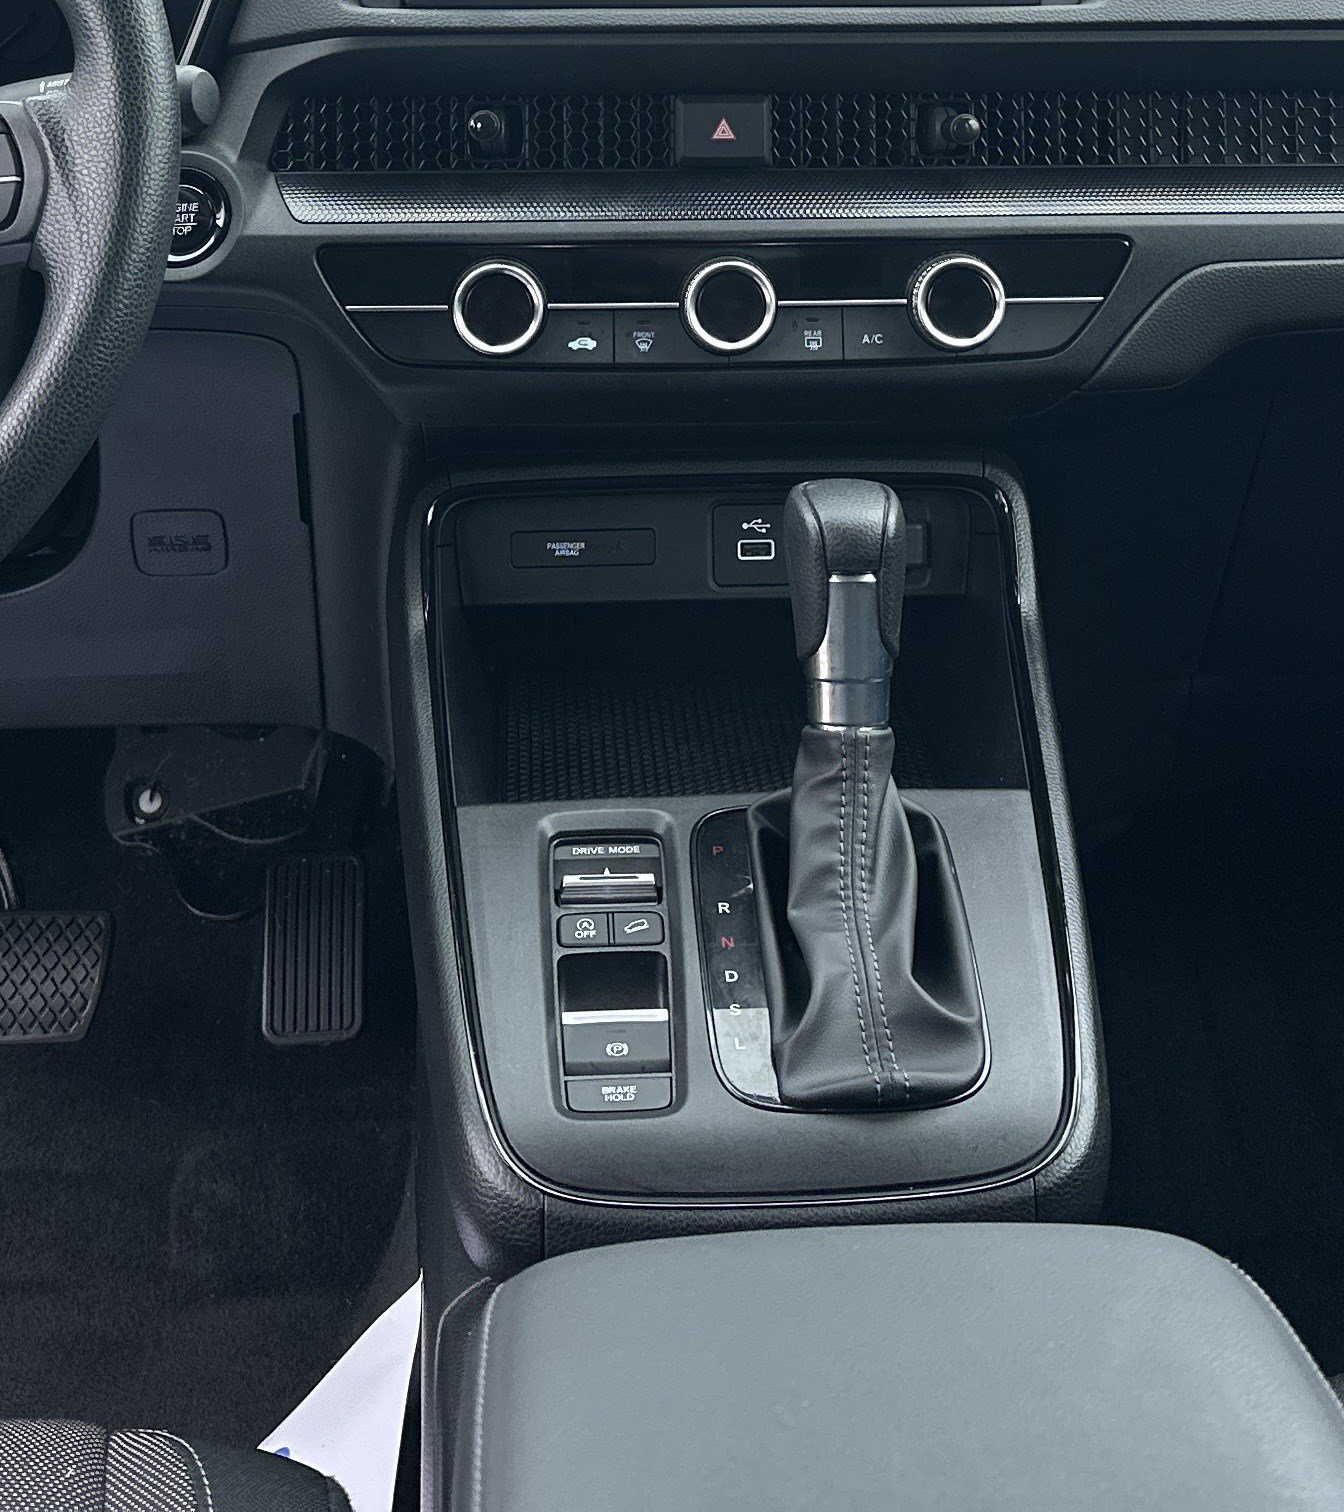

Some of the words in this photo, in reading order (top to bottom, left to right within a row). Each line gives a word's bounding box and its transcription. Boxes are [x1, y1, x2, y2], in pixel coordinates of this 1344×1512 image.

[176, 202, 199, 212] GINE
[174, 213, 197, 223] ART
[172, 226, 193, 236] TOP
[862, 334, 883, 345] A/C
[572, 847, 604, 855] DRIVE
[608, 846, 640, 855] MODE
[712, 846, 723, 856] P
[718, 902, 730, 914] R
[574, 929, 596, 939] OFF
[721, 936, 735, 948] N
[725, 970, 738, 982] D
[729, 1004, 741, 1016] S
[734, 1038, 746, 1050] L
[601, 1085, 637, 1095] BRAKE
[604, 1093, 635, 1102] HOLD
